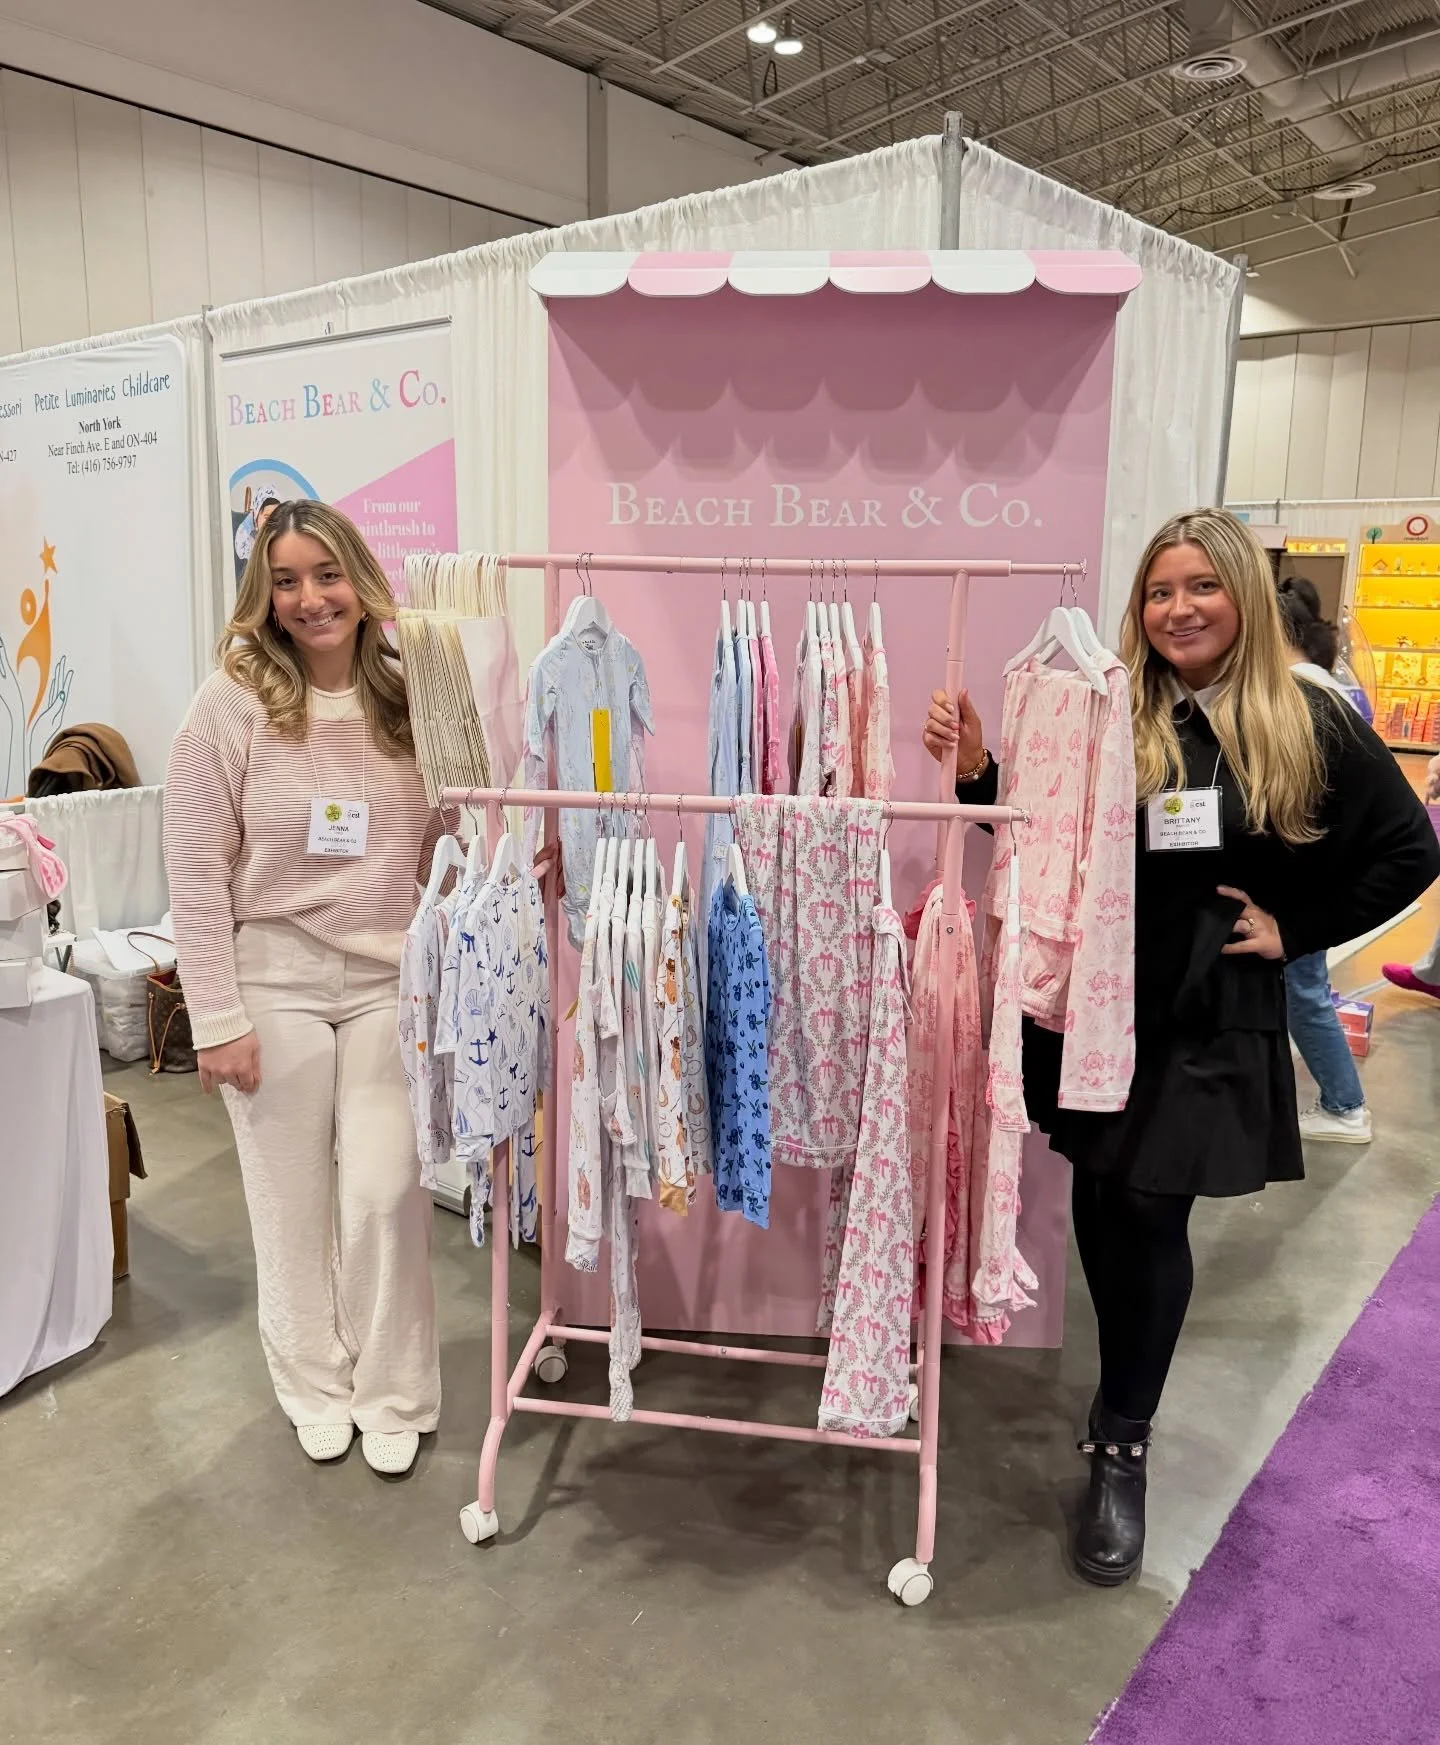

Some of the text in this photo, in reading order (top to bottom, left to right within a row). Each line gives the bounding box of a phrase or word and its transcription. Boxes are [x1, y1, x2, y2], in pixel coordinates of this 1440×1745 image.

[34, 370, 170, 412] Petite Luminaries Childcare
[228, 394, 296, 426] BEACH
[303, 384, 362, 418] BEAR
[369, 378, 391, 412] &
[78, 416, 122, 434] North York
[48, 431, 157, 458] Near Finch Ave. E and ON-404
[67, 454, 136, 477] Tel: (416) 756-9797
[363, 499, 421, 513] From our
[606, 482, 752, 526] BEACH
[770, 483, 888, 527] BEAR
[901, 486, 942, 529] &
[421, 521, 436, 536] to
